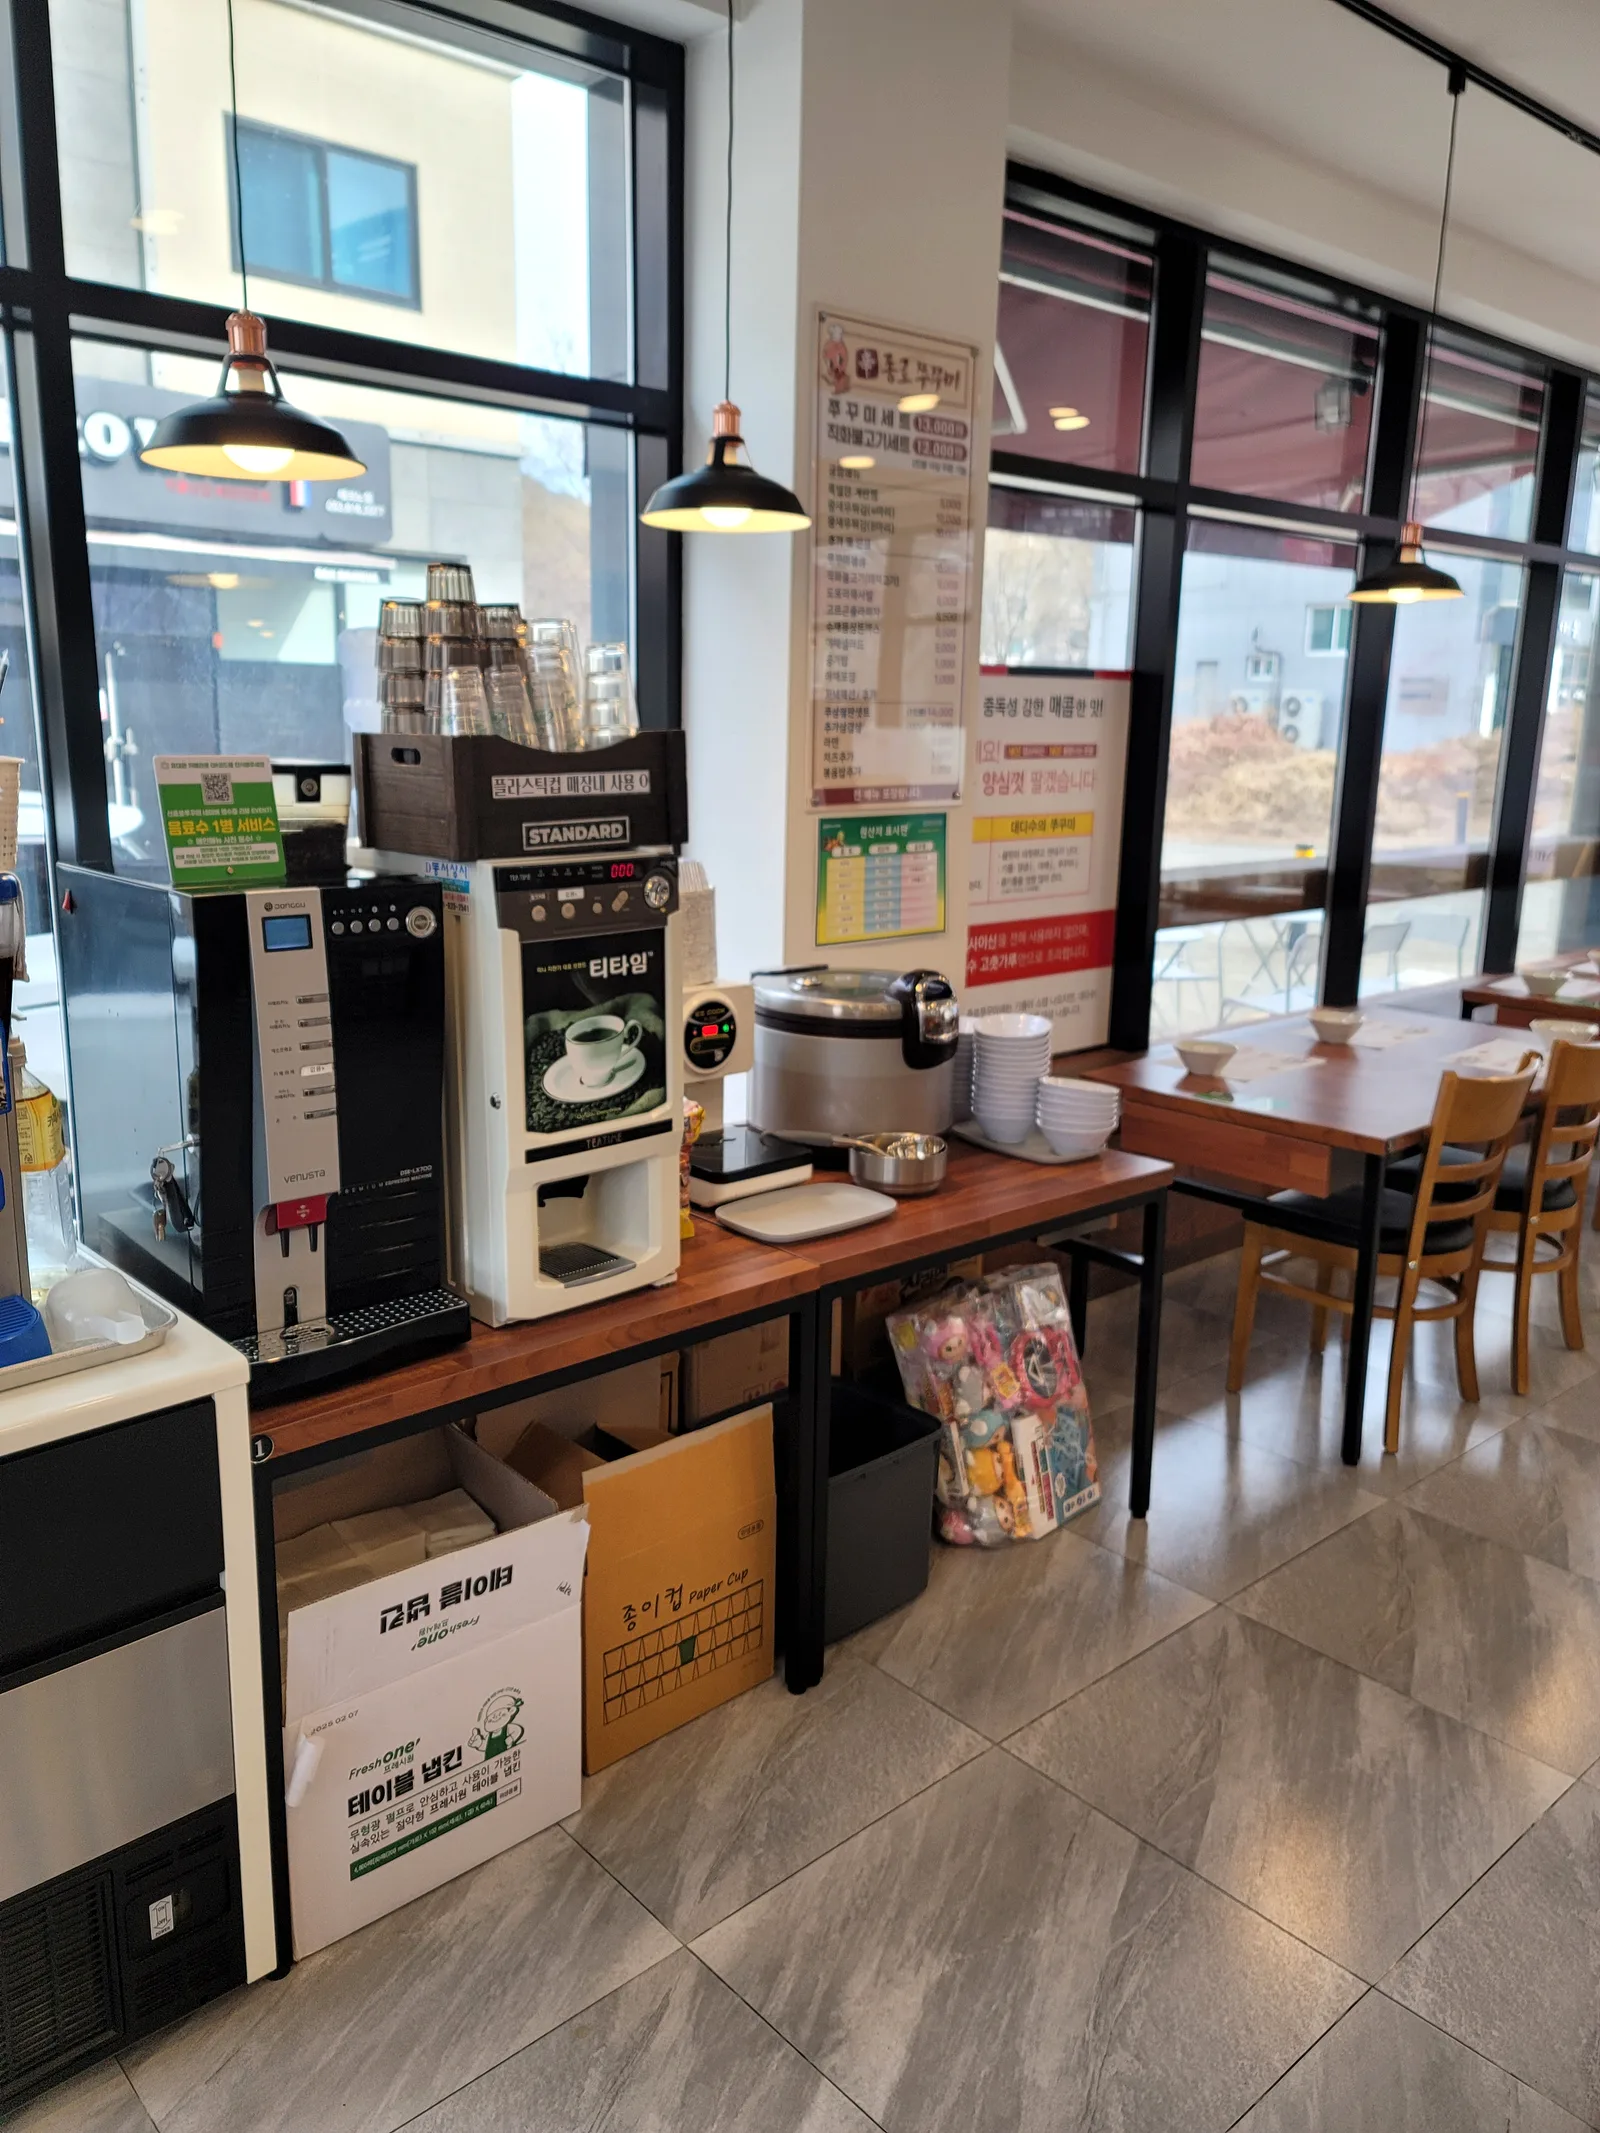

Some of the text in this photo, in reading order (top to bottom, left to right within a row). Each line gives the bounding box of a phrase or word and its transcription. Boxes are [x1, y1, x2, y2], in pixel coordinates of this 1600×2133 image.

[983, 696, 1018, 718] 중독성
[1022, 697, 1044, 718] 강한
[1049, 694, 1086, 719] 매콤한
[493, 776, 561, 797] 플라스틱컵
[566, 775, 606, 793] 매장내
[611, 773, 635, 791] 사용
[982, 768, 1096, 797] 양심껏 팔겠습니다
[168, 820, 209, 836] 음료수
[237, 817, 276, 833] 서비스
[528, 823, 624, 845] STANDARD
[611, 863, 635, 878] 000
[589, 951, 648, 979] 티타임
[379, 1564, 514, 1635] 테이블 냅킨
[622, 1568, 750, 1632] 종이컵 Paper Cup
[335, 1714, 347, 1725] 02
[348, 1709, 360, 1720] 07
[383, 1753, 414, 1774] 프레시원
[347, 1744, 463, 1818] 테이블 냅킨
[349, 1749, 522, 1842] 무형광 펄프로 안심하고 사용이 가능한
[349, 1828, 390, 1855] 실속있는
[395, 1810, 425, 1833] 절약형
[429, 1788, 467, 1815] 프레시원
[472, 1772, 499, 1793] 테이블
[503, 1760, 522, 1778] 냅킨
[155, 1926, 171, 1937] POWER
